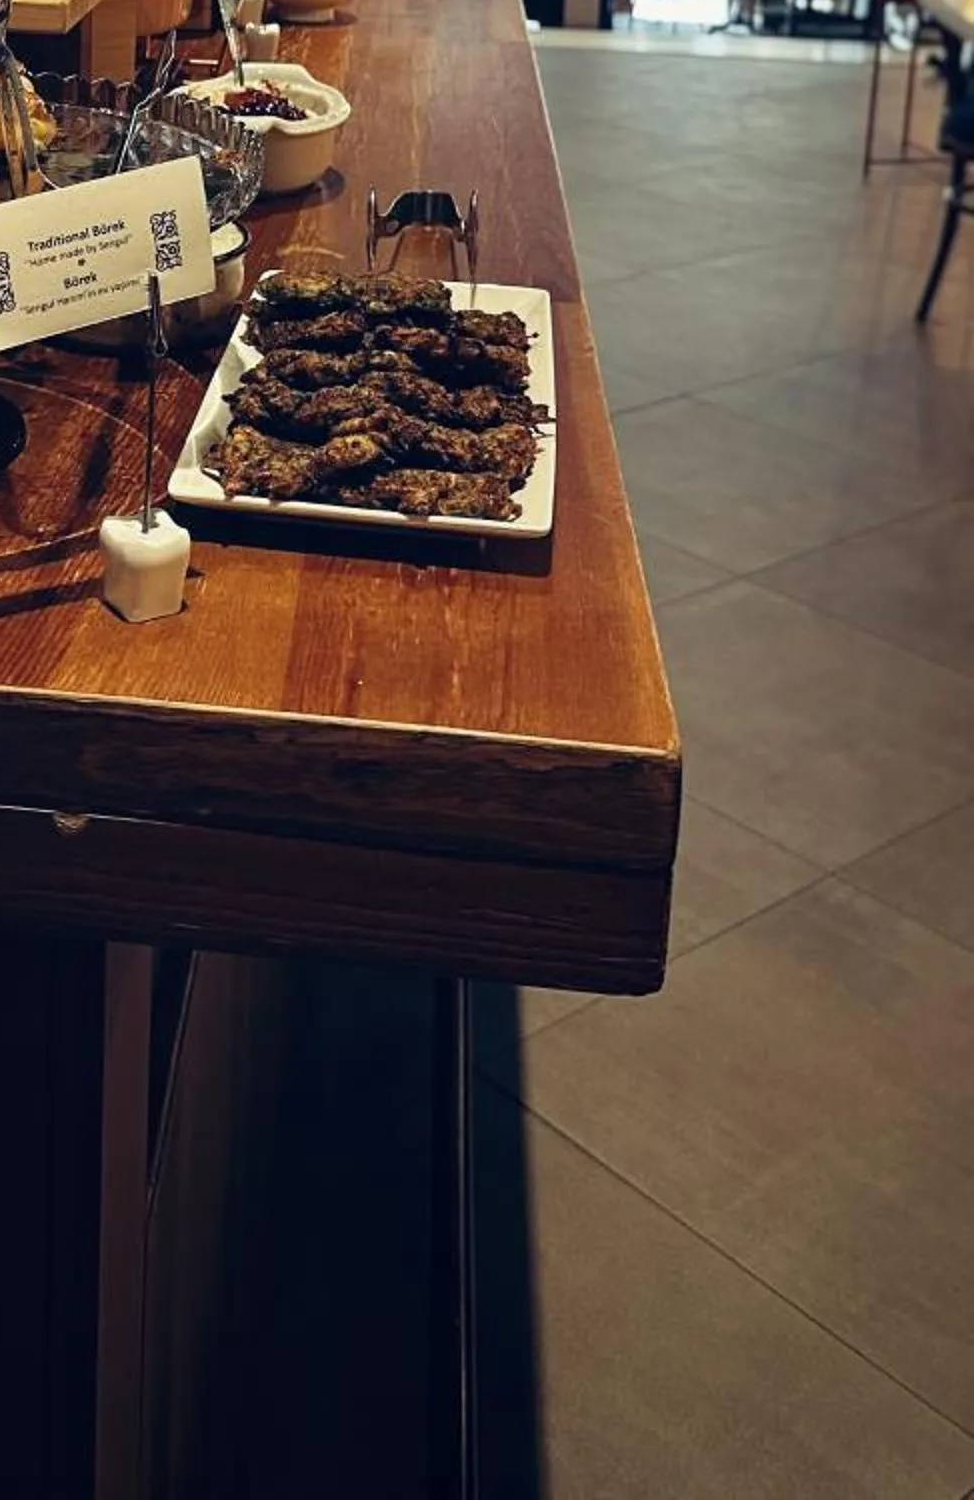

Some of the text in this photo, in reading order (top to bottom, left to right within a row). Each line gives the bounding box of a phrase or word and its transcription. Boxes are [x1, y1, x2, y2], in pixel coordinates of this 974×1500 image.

[28, 219, 125, 252] Traditional Börek
[59, 246, 84, 260] made
[85, 244, 97, 255] by
[64, 271, 97, 289] Börek
